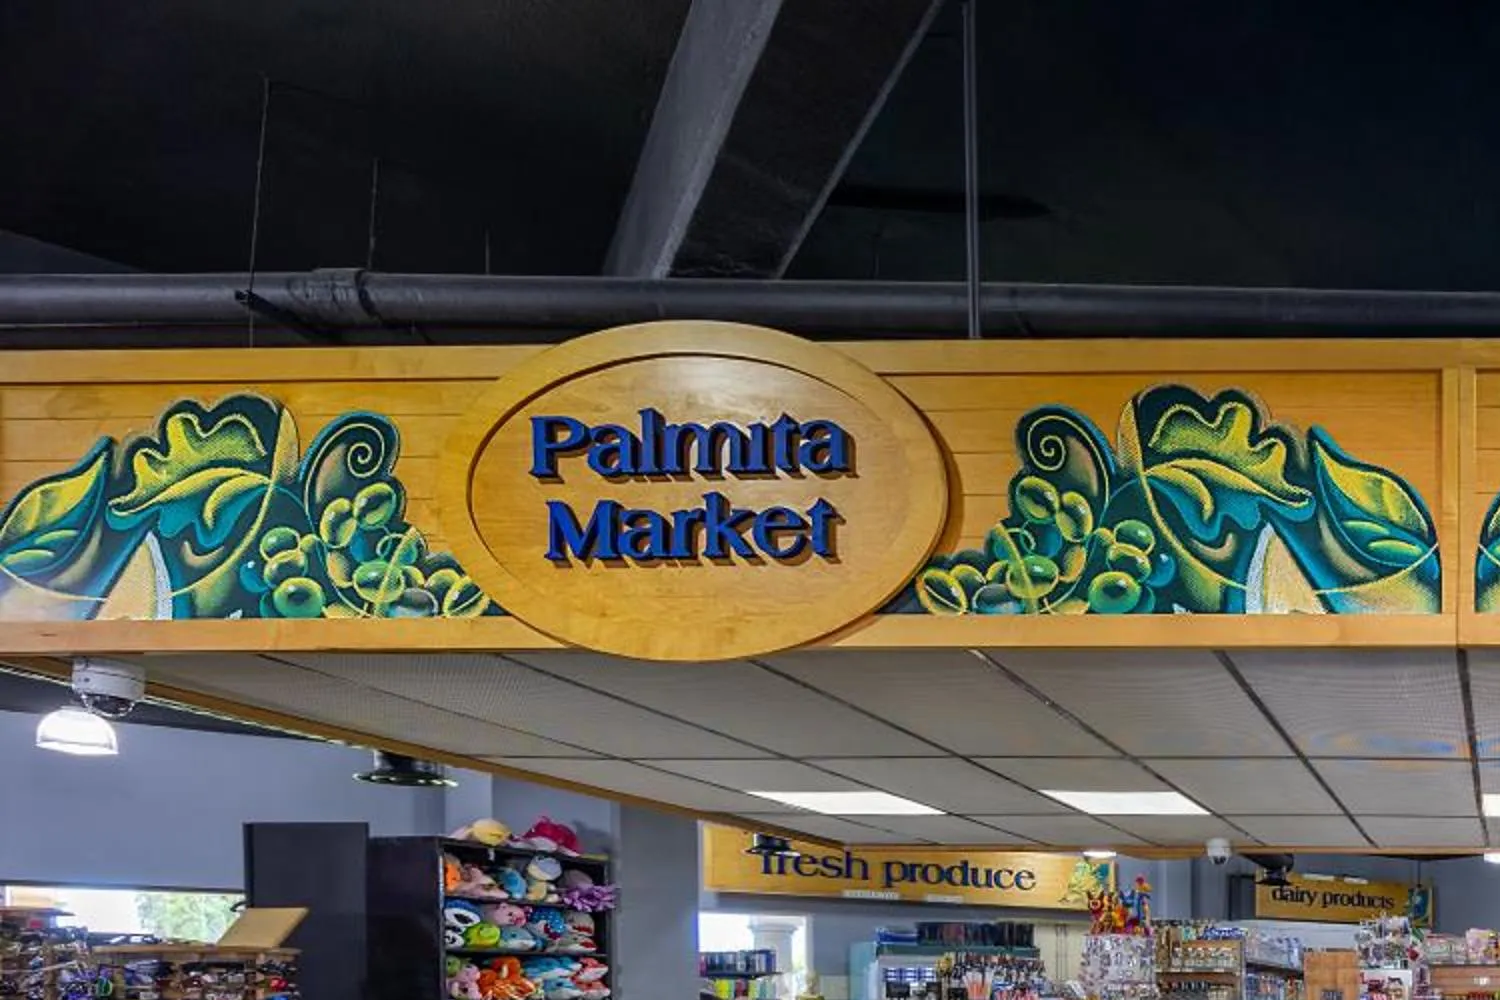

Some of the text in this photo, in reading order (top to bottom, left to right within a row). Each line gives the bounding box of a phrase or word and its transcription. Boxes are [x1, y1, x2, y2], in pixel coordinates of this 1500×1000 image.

[528, 407, 854, 479] Palmita
[544, 491, 846, 562] Market
[761, 849, 1036, 891] fresh produce
[1272, 885, 1395, 909] dairy products
